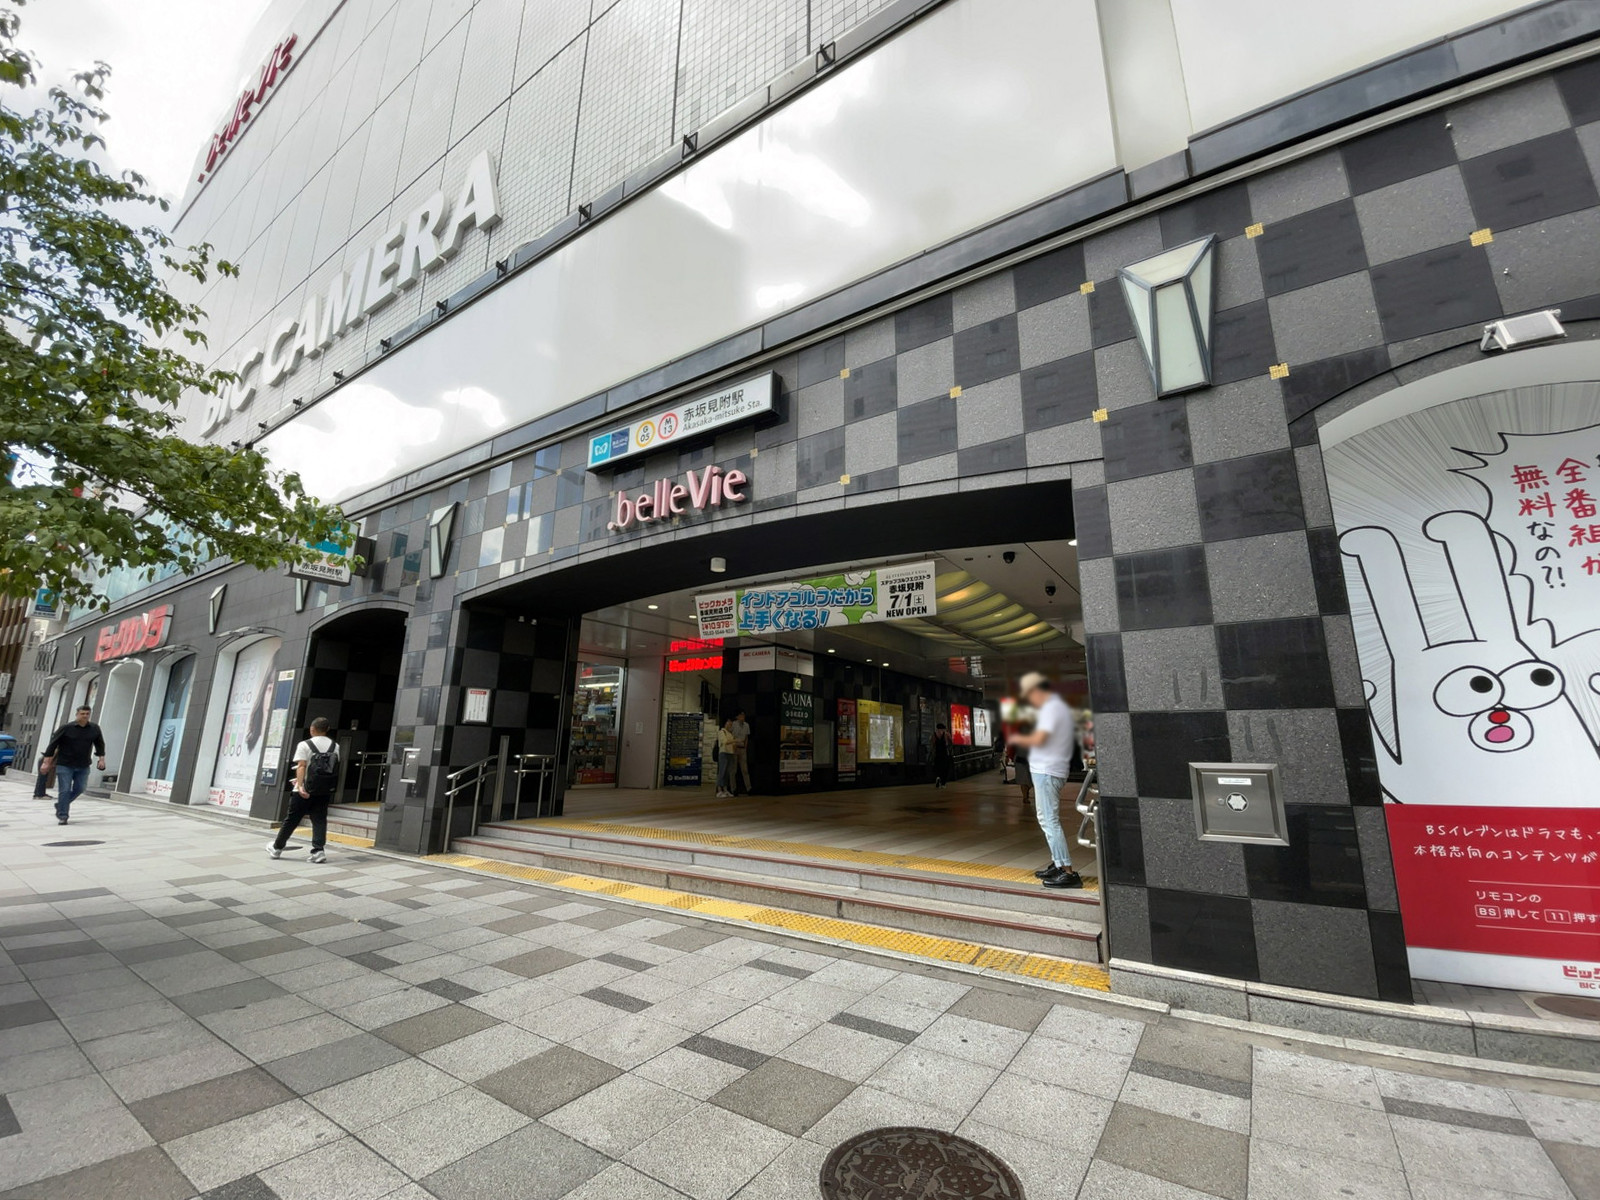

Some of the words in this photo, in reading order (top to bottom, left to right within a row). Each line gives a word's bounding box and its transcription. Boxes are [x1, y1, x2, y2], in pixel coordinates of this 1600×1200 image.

[262, 149, 503, 388] CAMERA
[683, 388, 745, 423] 赤坂見附駅
[664, 417, 672, 425] M
[682, 404, 746, 433] Akasaka-mitsuke
[746, 399, 763, 411] Sta.
[642, 425, 648, 434] G
[663, 425, 673, 434] 13
[640, 434, 650, 442] 05
[889, 580, 924, 594] 赤坂見附
[698, 597, 734, 609] ビックカメラ
[741, 587, 873, 608] インドアゴルフだから
[889, 593, 912, 609] 7/1
[886, 608, 904, 618] NEW
[905, 605, 927, 615] OPEN
[782, 691, 812, 708] SAUNA
[1413, 845, 1598, 864] 本格志向のコンテンツが
[1475, 890, 1542, 904] リモコンの
[1478, 907, 1497, 917] BS
[1503, 907, 1540, 920] 押して
[1550, 912, 1565, 922] 11
